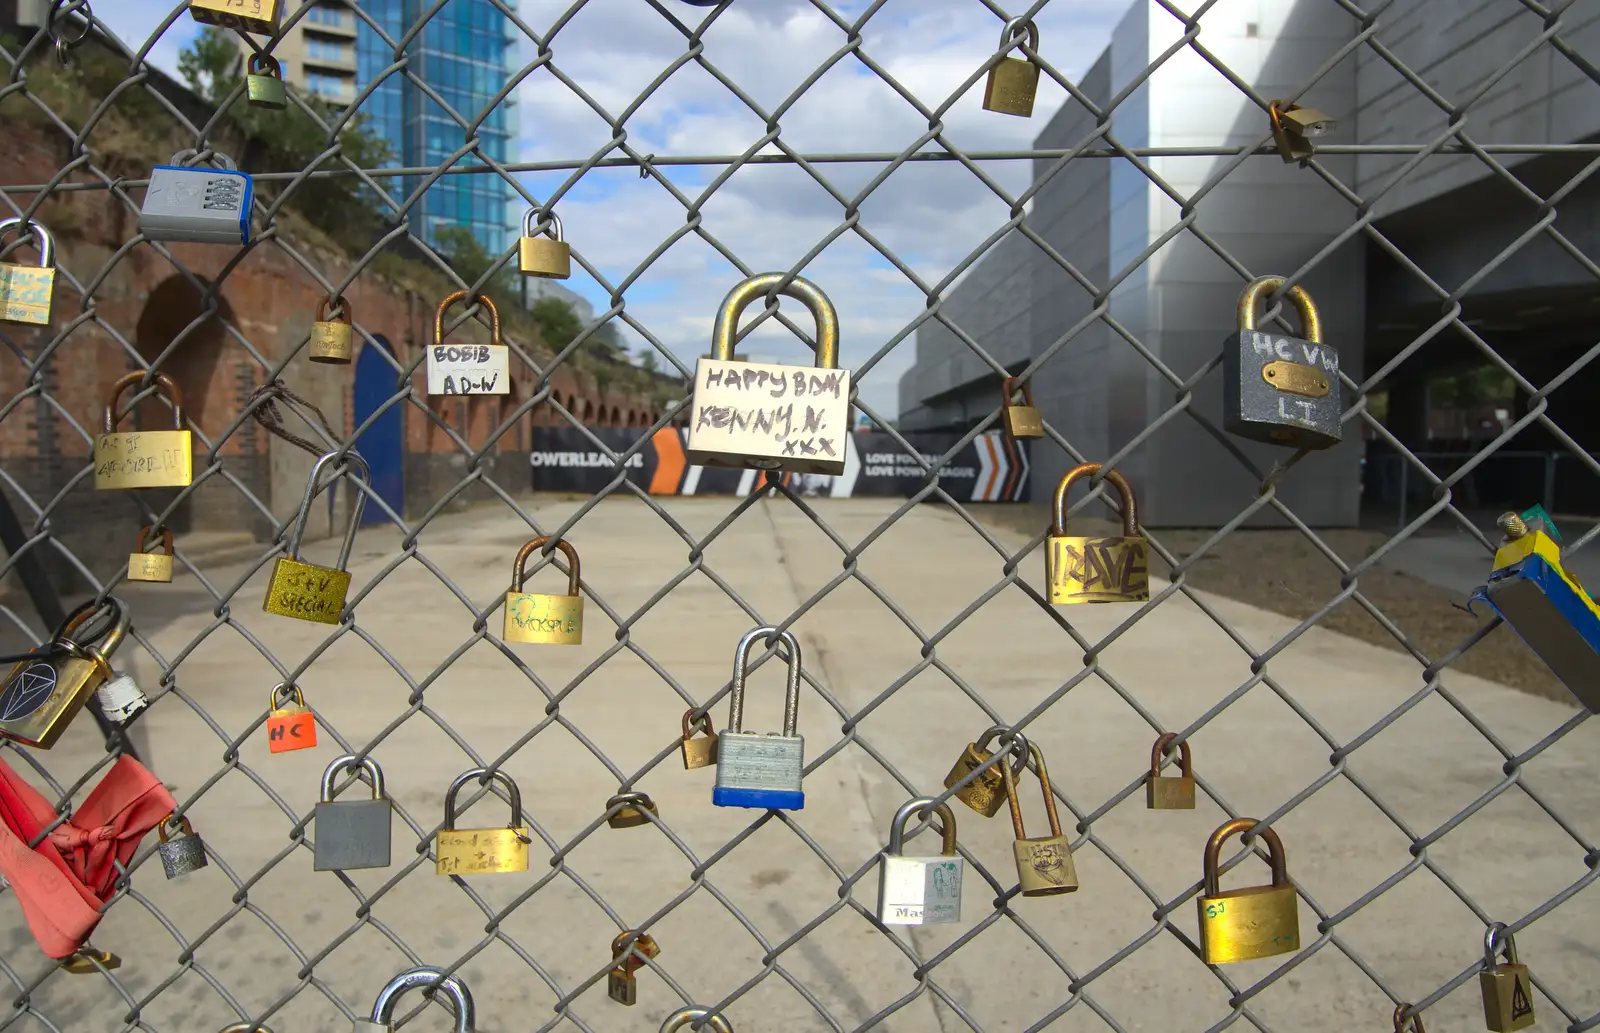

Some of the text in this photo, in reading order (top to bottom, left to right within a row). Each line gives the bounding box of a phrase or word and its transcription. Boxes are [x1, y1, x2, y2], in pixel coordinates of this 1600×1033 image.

[1253, 332, 1293, 360] HC
[706, 367, 787, 398] HAPPY
[530, 451, 644, 468] OWERLEAUE
[865, 453, 894, 464] LOVE
[865, 465, 894, 476] LOVE
